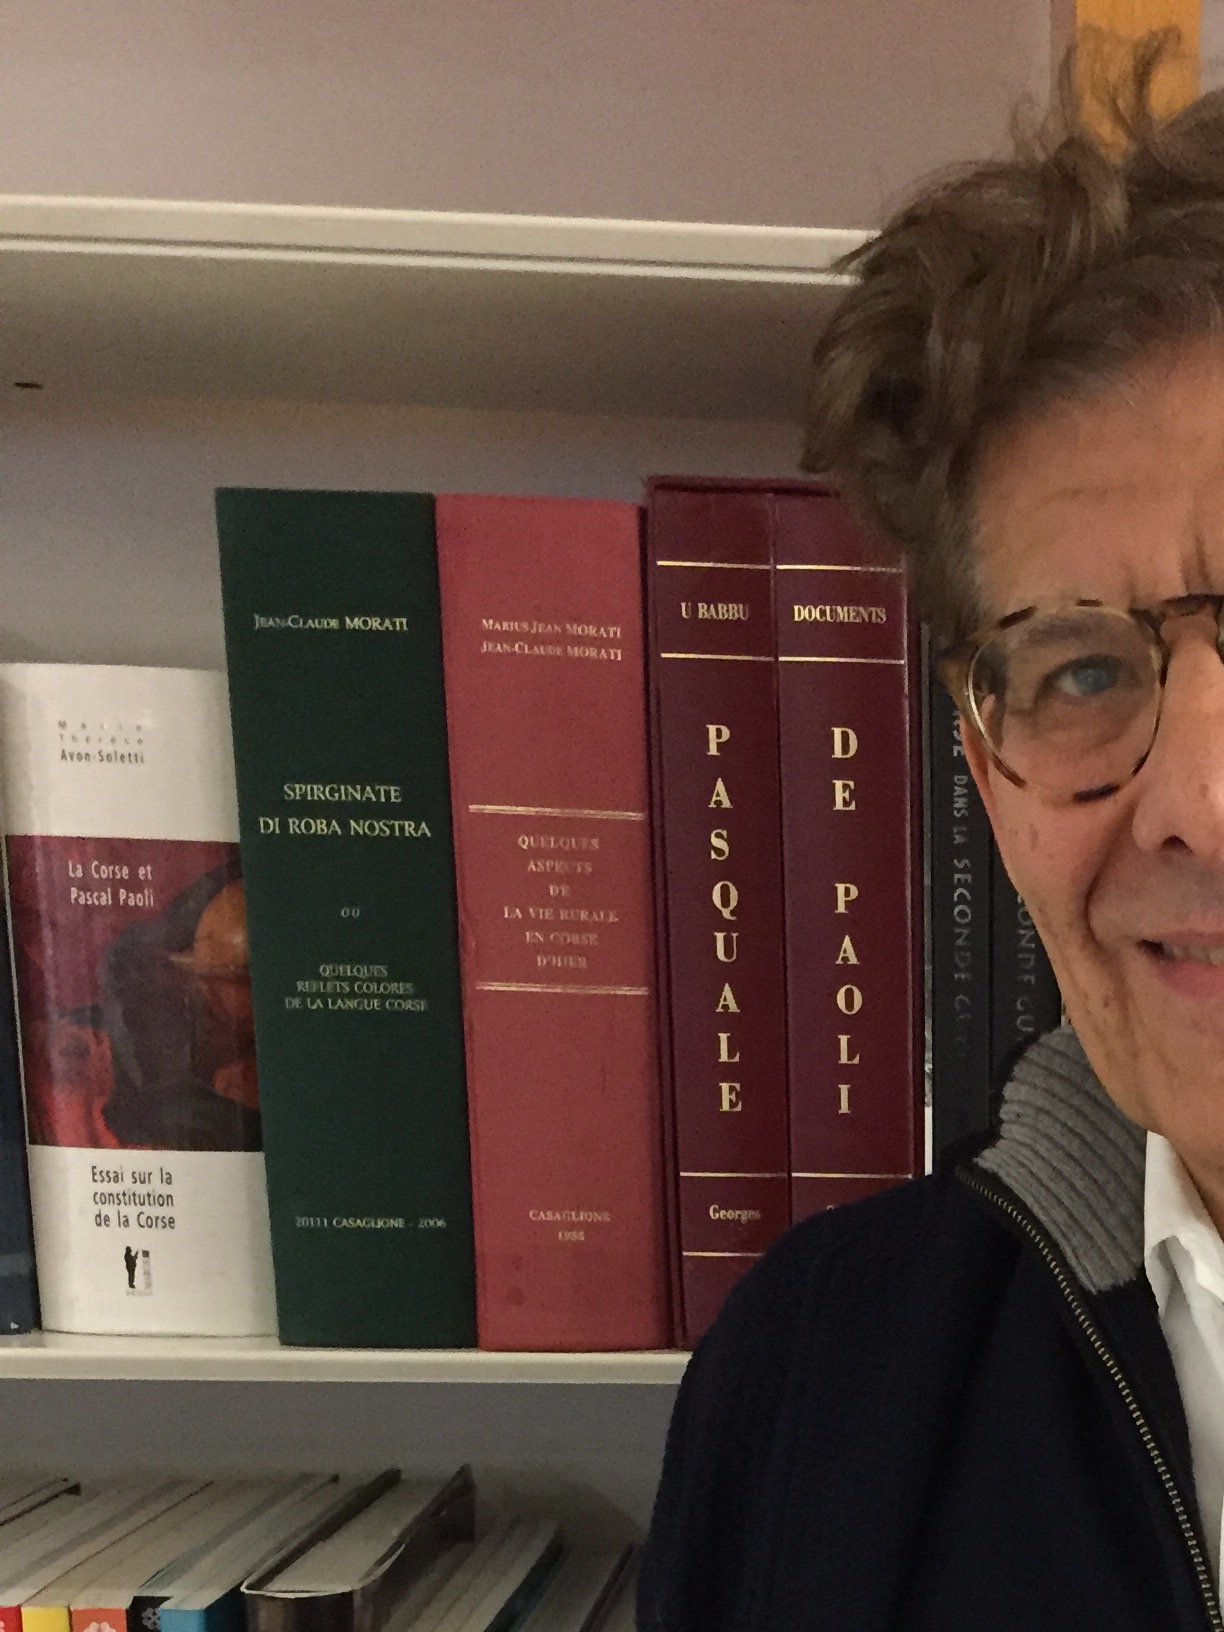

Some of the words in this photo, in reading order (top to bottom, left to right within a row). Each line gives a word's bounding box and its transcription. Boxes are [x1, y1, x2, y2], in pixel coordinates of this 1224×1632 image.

[680, 602, 692, 620] U
[697, 602, 750, 623] BABBU
[793, 604, 886, 624] DOCUMENTS
[345, 616, 408, 631] MORATI
[566, 623, 622, 639] MORATI
[567, 645, 622, 661] MORATI
[283, 783, 402, 803] SPIRGINATE
[953, 775, 969, 818] DANS
[259, 816, 280, 834] DI
[288, 817, 342, 836] ROBA
[349, 818, 432, 838] NOSTRA
[68, 860, 84, 878] La
[92, 860, 129, 880] Corse
[138, 864, 152, 881] et
[70, 887, 112, 906] Pascal
[119, 888, 154, 907] Paoli
[953, 859, 972, 981] SECONDE
[307, 998, 324, 1010] LA
[328, 998, 381, 1011] LANGUE
[91, 1165, 125, 1184] Essai
[131, 1171, 152, 1184] sur
[160, 1167, 173, 1185] la
[93, 1189, 174, 1207] constitution
[94, 1208, 111, 1227] de
[117, 1210, 130, 1228] la
[137, 1211, 176, 1229] Corse
[709, 1204, 761, 1222] Georges
